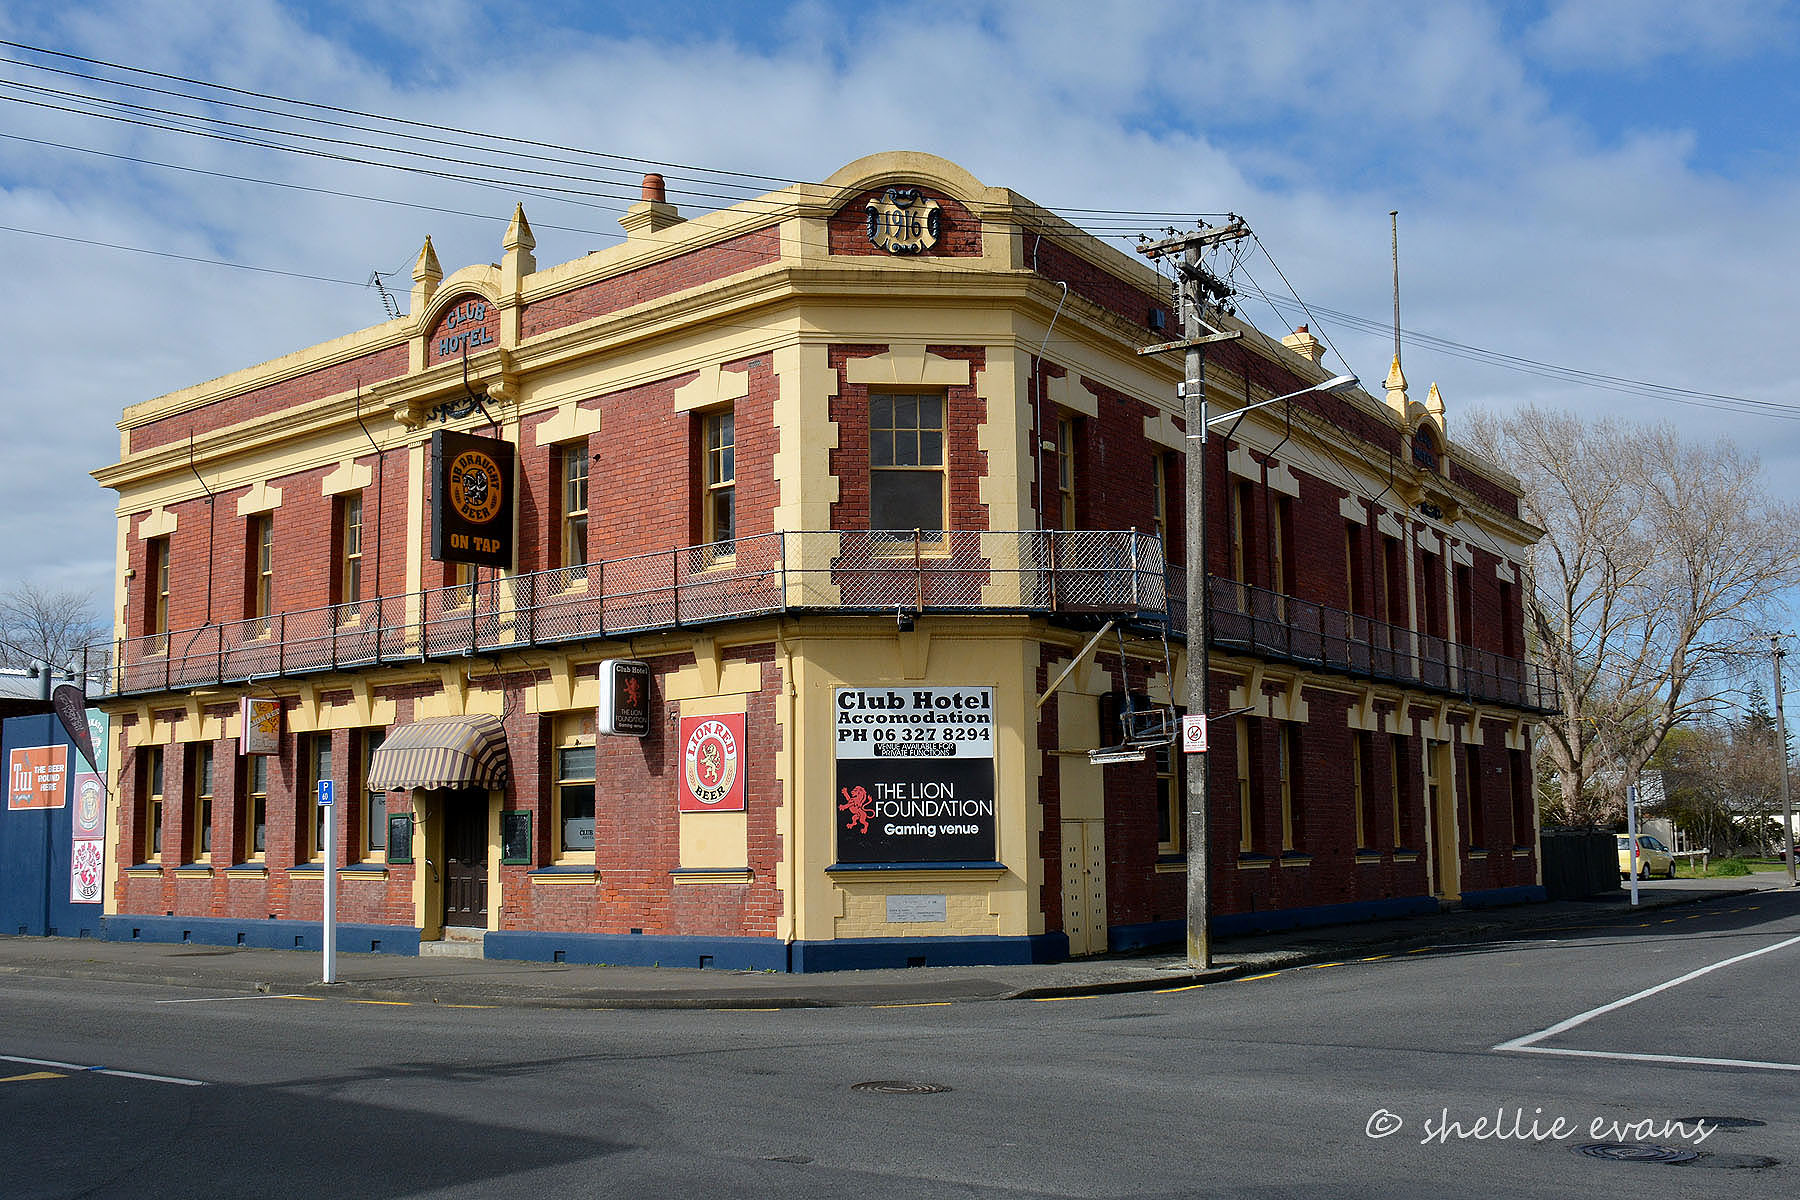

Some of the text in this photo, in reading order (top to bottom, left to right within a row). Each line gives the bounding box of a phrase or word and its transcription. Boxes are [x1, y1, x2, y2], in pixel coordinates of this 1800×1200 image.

[885, 210, 921, 241] 1916
[447, 302, 486, 330] CLUB
[439, 327, 493, 356] HOTEL
[452, 454, 500, 490] DB DRAUGHT
[461, 504, 490, 520] BEER
[450, 533, 500, 553] ON TAP
[616, 665, 648, 674] Club Hotel
[838, 692, 990, 710] Club Hotel
[838, 710, 990, 724] Accomodation
[688, 723, 735, 756] LION RED
[838, 728, 990, 742] PH 06 327 8294
[34, 764, 64, 774] THE BEER
[14, 763, 32, 792] Tui
[38, 774, 60, 782] ROUND
[40, 783, 57, 792] HERE
[323, 782, 328, 792] P
[695, 785, 726, 801] BEER
[874, 782, 954, 799] THE LION
[322, 792, 328, 800] 60
[875, 800, 993, 818] FOUNDATION
[884, 823, 979, 838] Gaming venue
